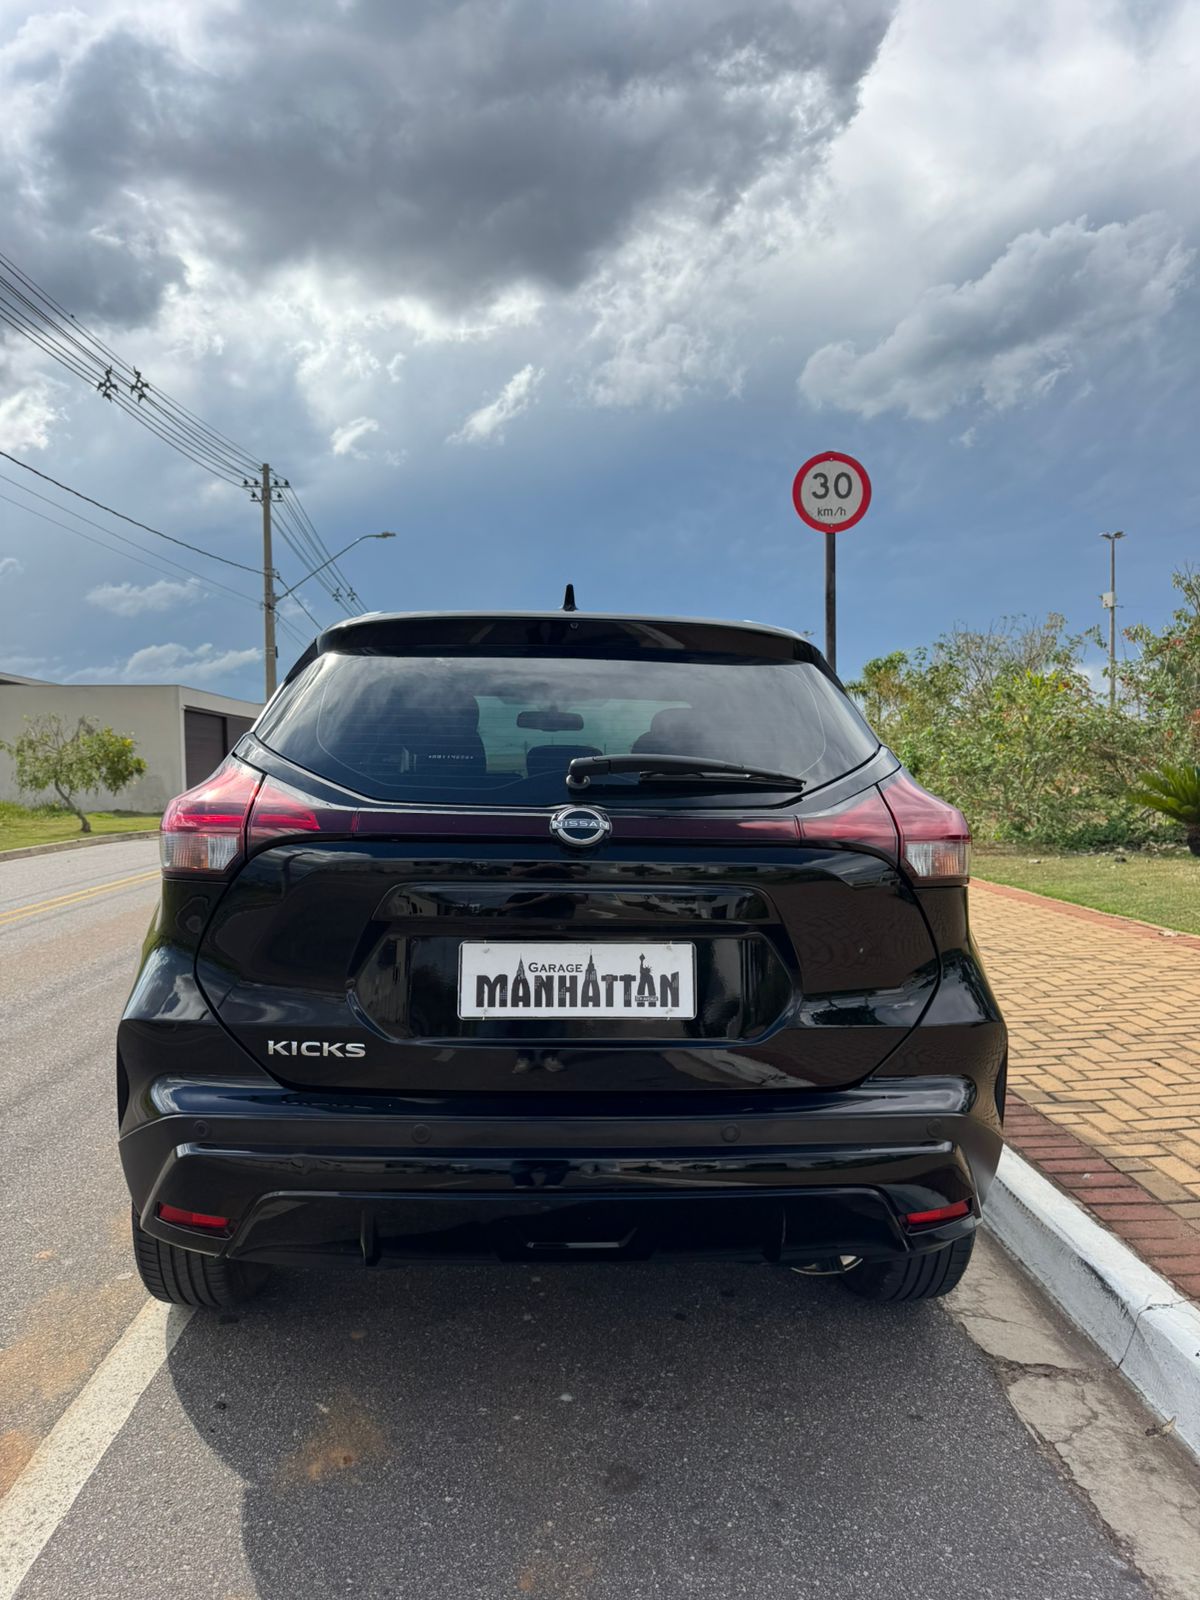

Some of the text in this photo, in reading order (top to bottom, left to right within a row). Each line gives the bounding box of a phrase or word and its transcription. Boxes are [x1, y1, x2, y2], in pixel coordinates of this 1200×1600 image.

[812, 472, 853, 499] 30
[817, 507, 847, 517] km/h
[554, 820, 608, 828] NISSAN
[528, 962, 583, 973] GARAGE
[476, 966, 680, 1008] MANHATTAN
[267, 1040, 366, 1058] KICKS
